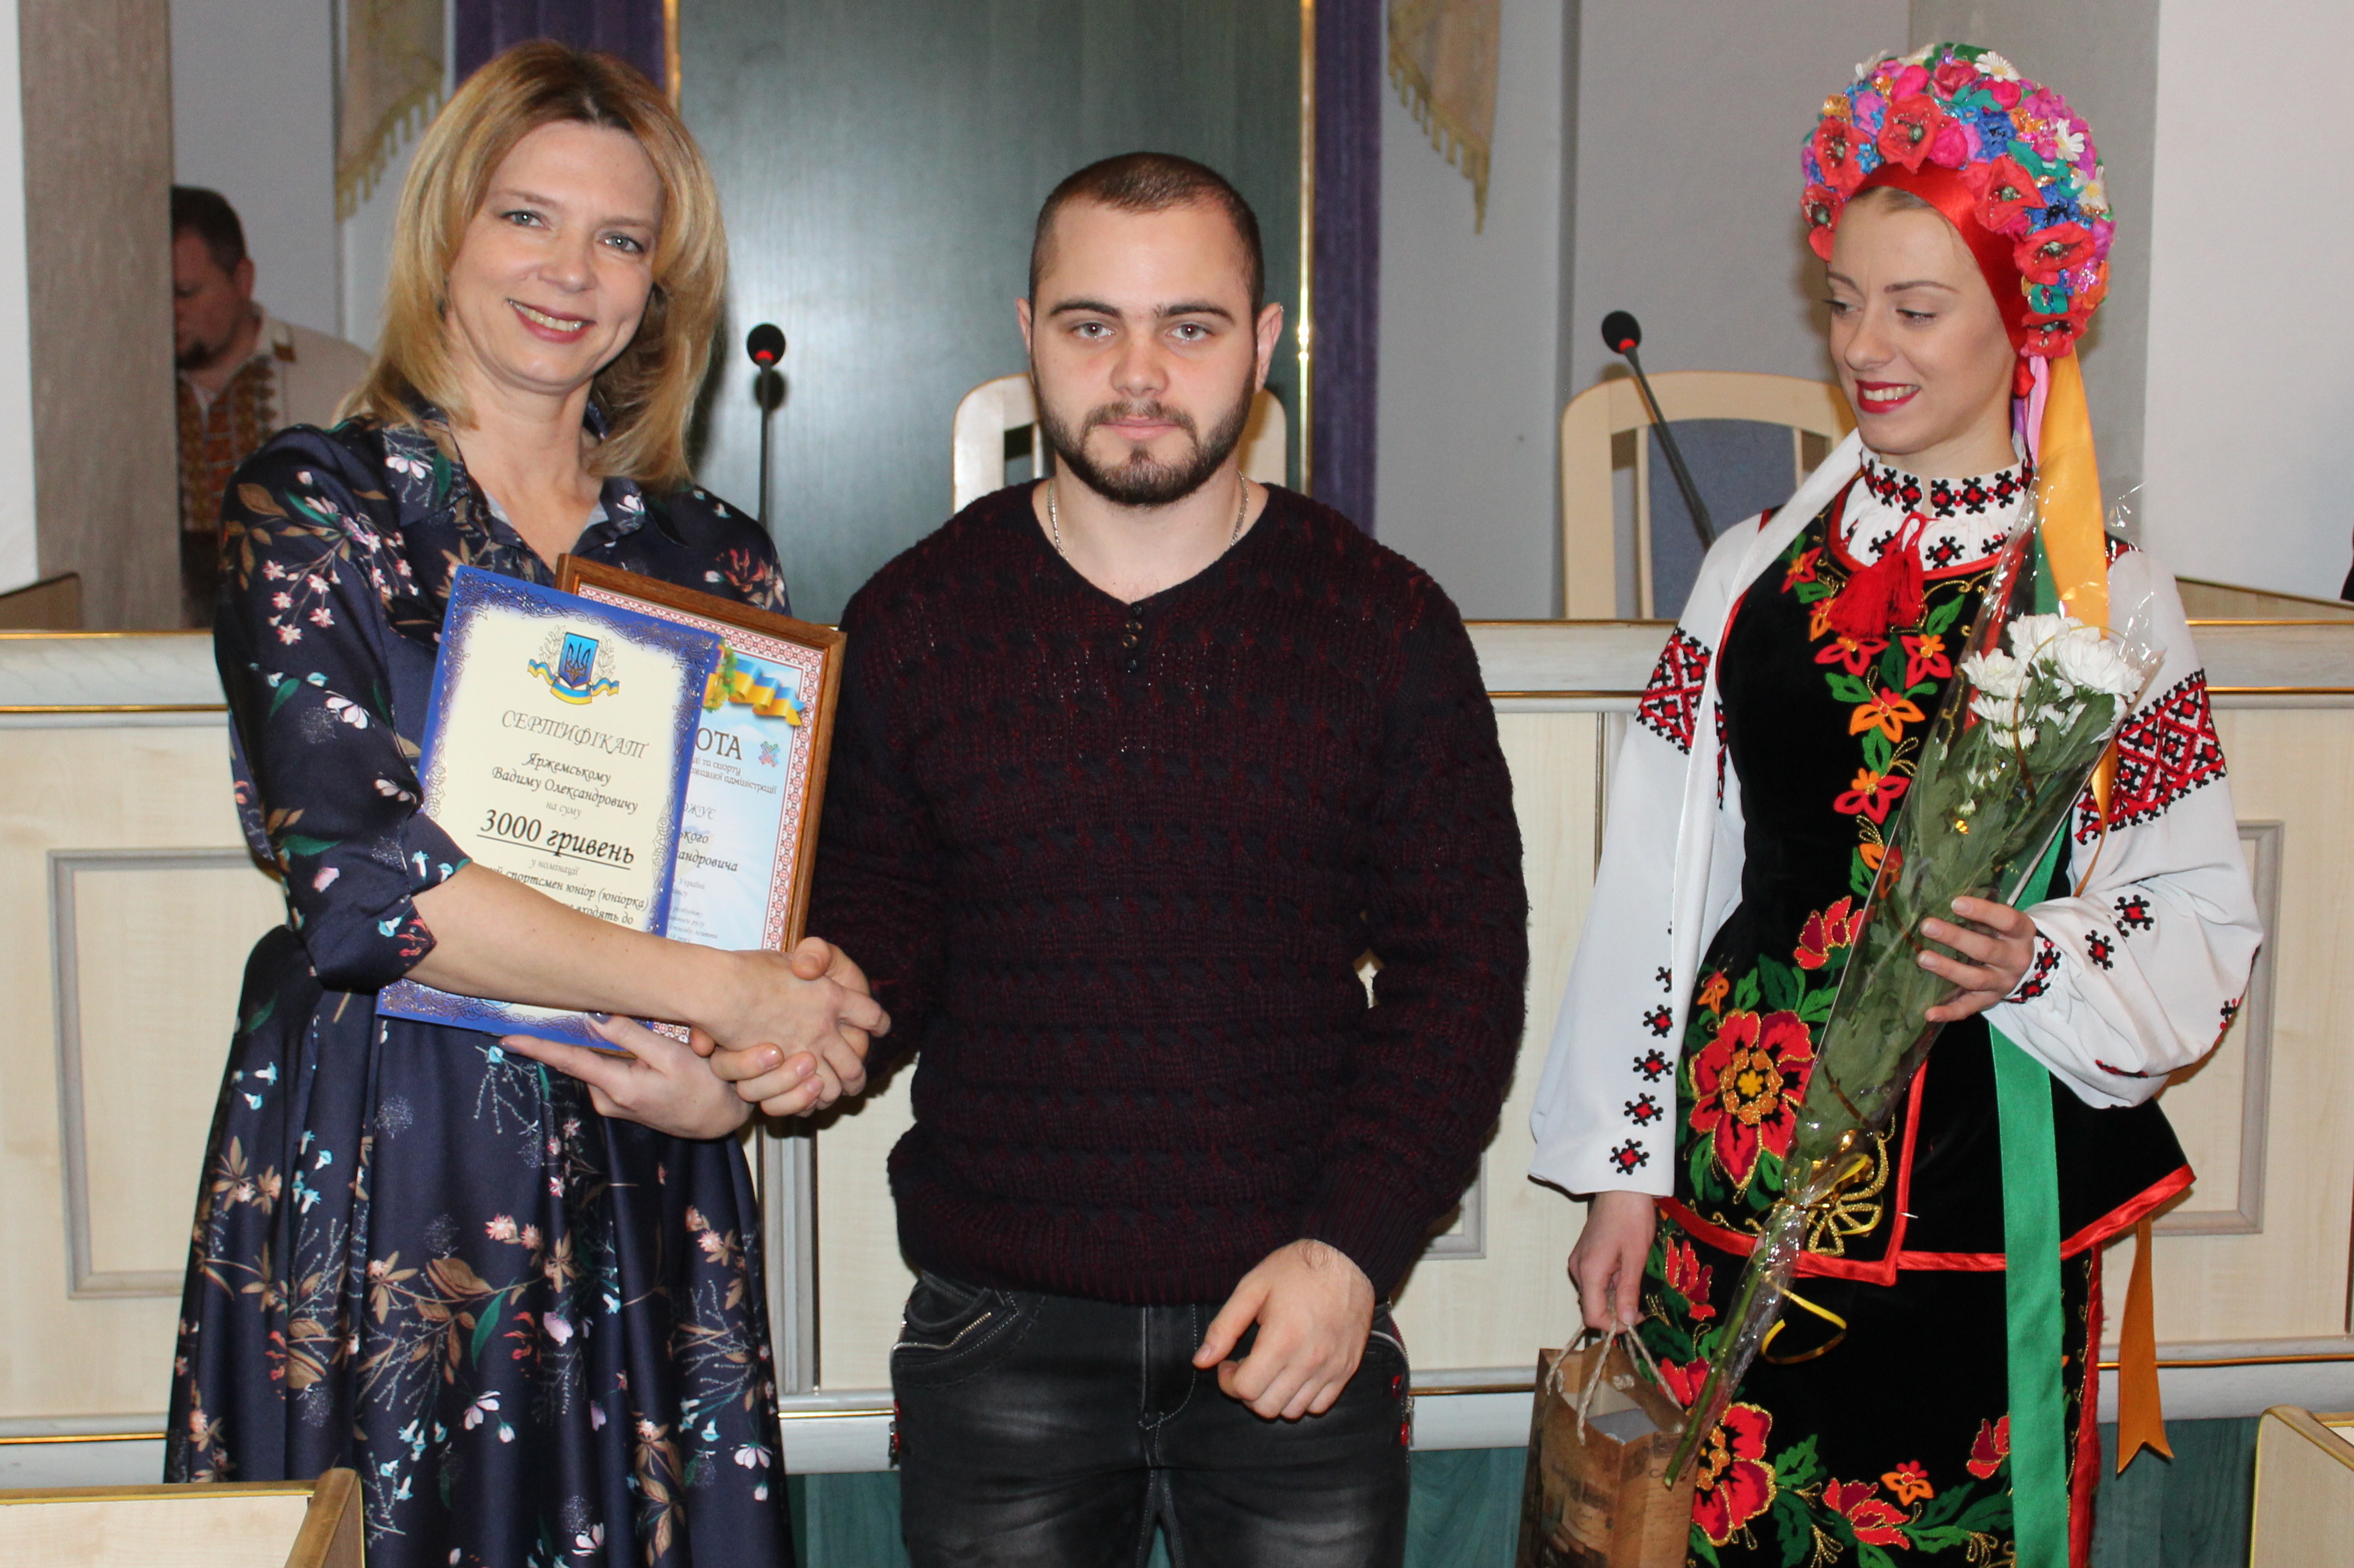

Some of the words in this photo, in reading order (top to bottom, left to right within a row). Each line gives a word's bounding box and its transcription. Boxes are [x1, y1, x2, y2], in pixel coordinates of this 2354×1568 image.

[502, 710, 649, 759] СЕРТИФІКАТ
[521, 753, 610, 786] Яржемському
[702, 757, 712, 766] та
[712, 761, 741, 776] спорту
[492, 767, 542, 792] Вадиму
[545, 779, 638, 815] Олександровичу
[724, 775, 778, 794] адміністрації
[546, 802, 557, 811] на
[559, 805, 582, 819] суму
[480, 809, 542, 842] 3000
[546, 830, 634, 864] гривень
[529, 859, 536, 868] у
[538, 861, 580, 876] номінації
[506, 871, 563, 890] спортсмен
[566, 884, 596, 901] юніор
[598, 888, 649, 911] (юніорка)
[621, 911, 634, 925] до
